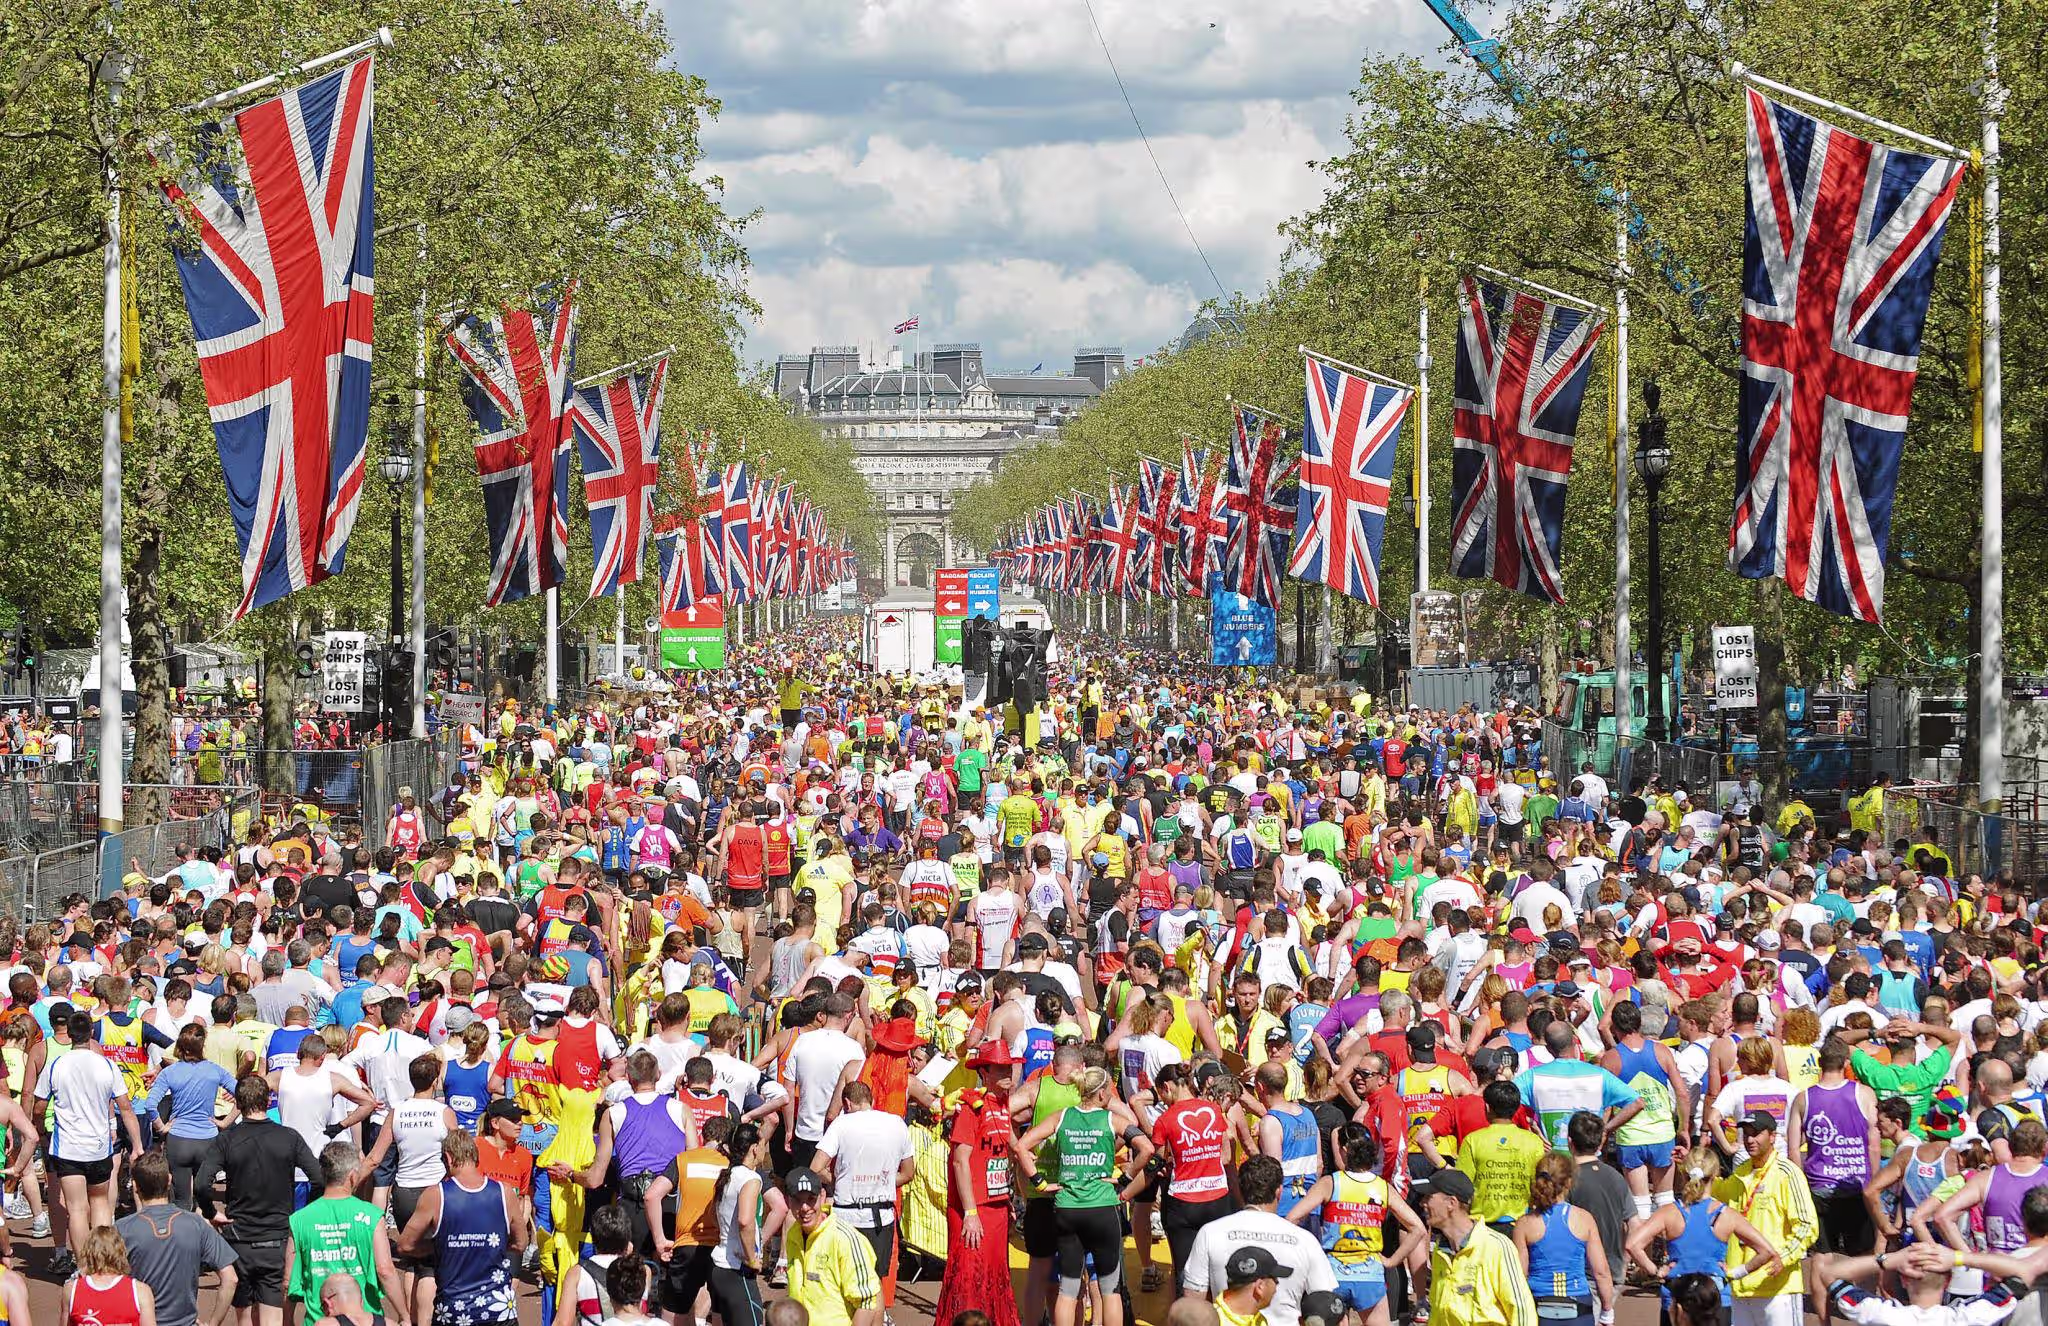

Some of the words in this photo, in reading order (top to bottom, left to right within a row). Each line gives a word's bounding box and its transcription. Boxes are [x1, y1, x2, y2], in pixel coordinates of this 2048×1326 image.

[1231, 614, 1254, 622] BLUE
[1222, 623, 1265, 631] NUMBERS
[330, 640, 358, 650] LOST
[1720, 635, 1749, 645] LOST
[326, 653, 362, 663] CHIPS
[1716, 649, 1753, 659] CHIPS
[329, 681, 357, 691] LOST
[1720, 677, 1751, 686] LOST
[1717, 689, 1755, 699] CHIPS
[324, 695, 360, 704] CHIPS
[738, 838, 758, 846] DAVE
[871, 944, 892, 952] icta
[692, 1021, 709, 1029] ANN
[103, 1045, 138, 1054] CHILDREN
[511, 1060, 546, 1070] CHILDREN
[1403, 1094, 1444, 1103] CHILDREN
[400, 1121, 434, 1129] THEATRE
[1069, 1136, 1097, 1144] depending
[1182, 1146, 1204, 1156] British
[1822, 1146, 1865, 1155] Ormond
[1486, 1160, 1526, 1170] Changing
[1833, 1155, 1866, 1165] Street
[1823, 1165, 1866, 1176] Hospital
[1336, 1202, 1382, 1213] CHILDREN
[1351, 1211, 1368, 1219] with
[1333, 1216, 1382, 1227] LEUKAEMIA
[1228, 1231, 1298, 1245] SHOULDERS
[311, 1246, 356, 1262] teamGO
